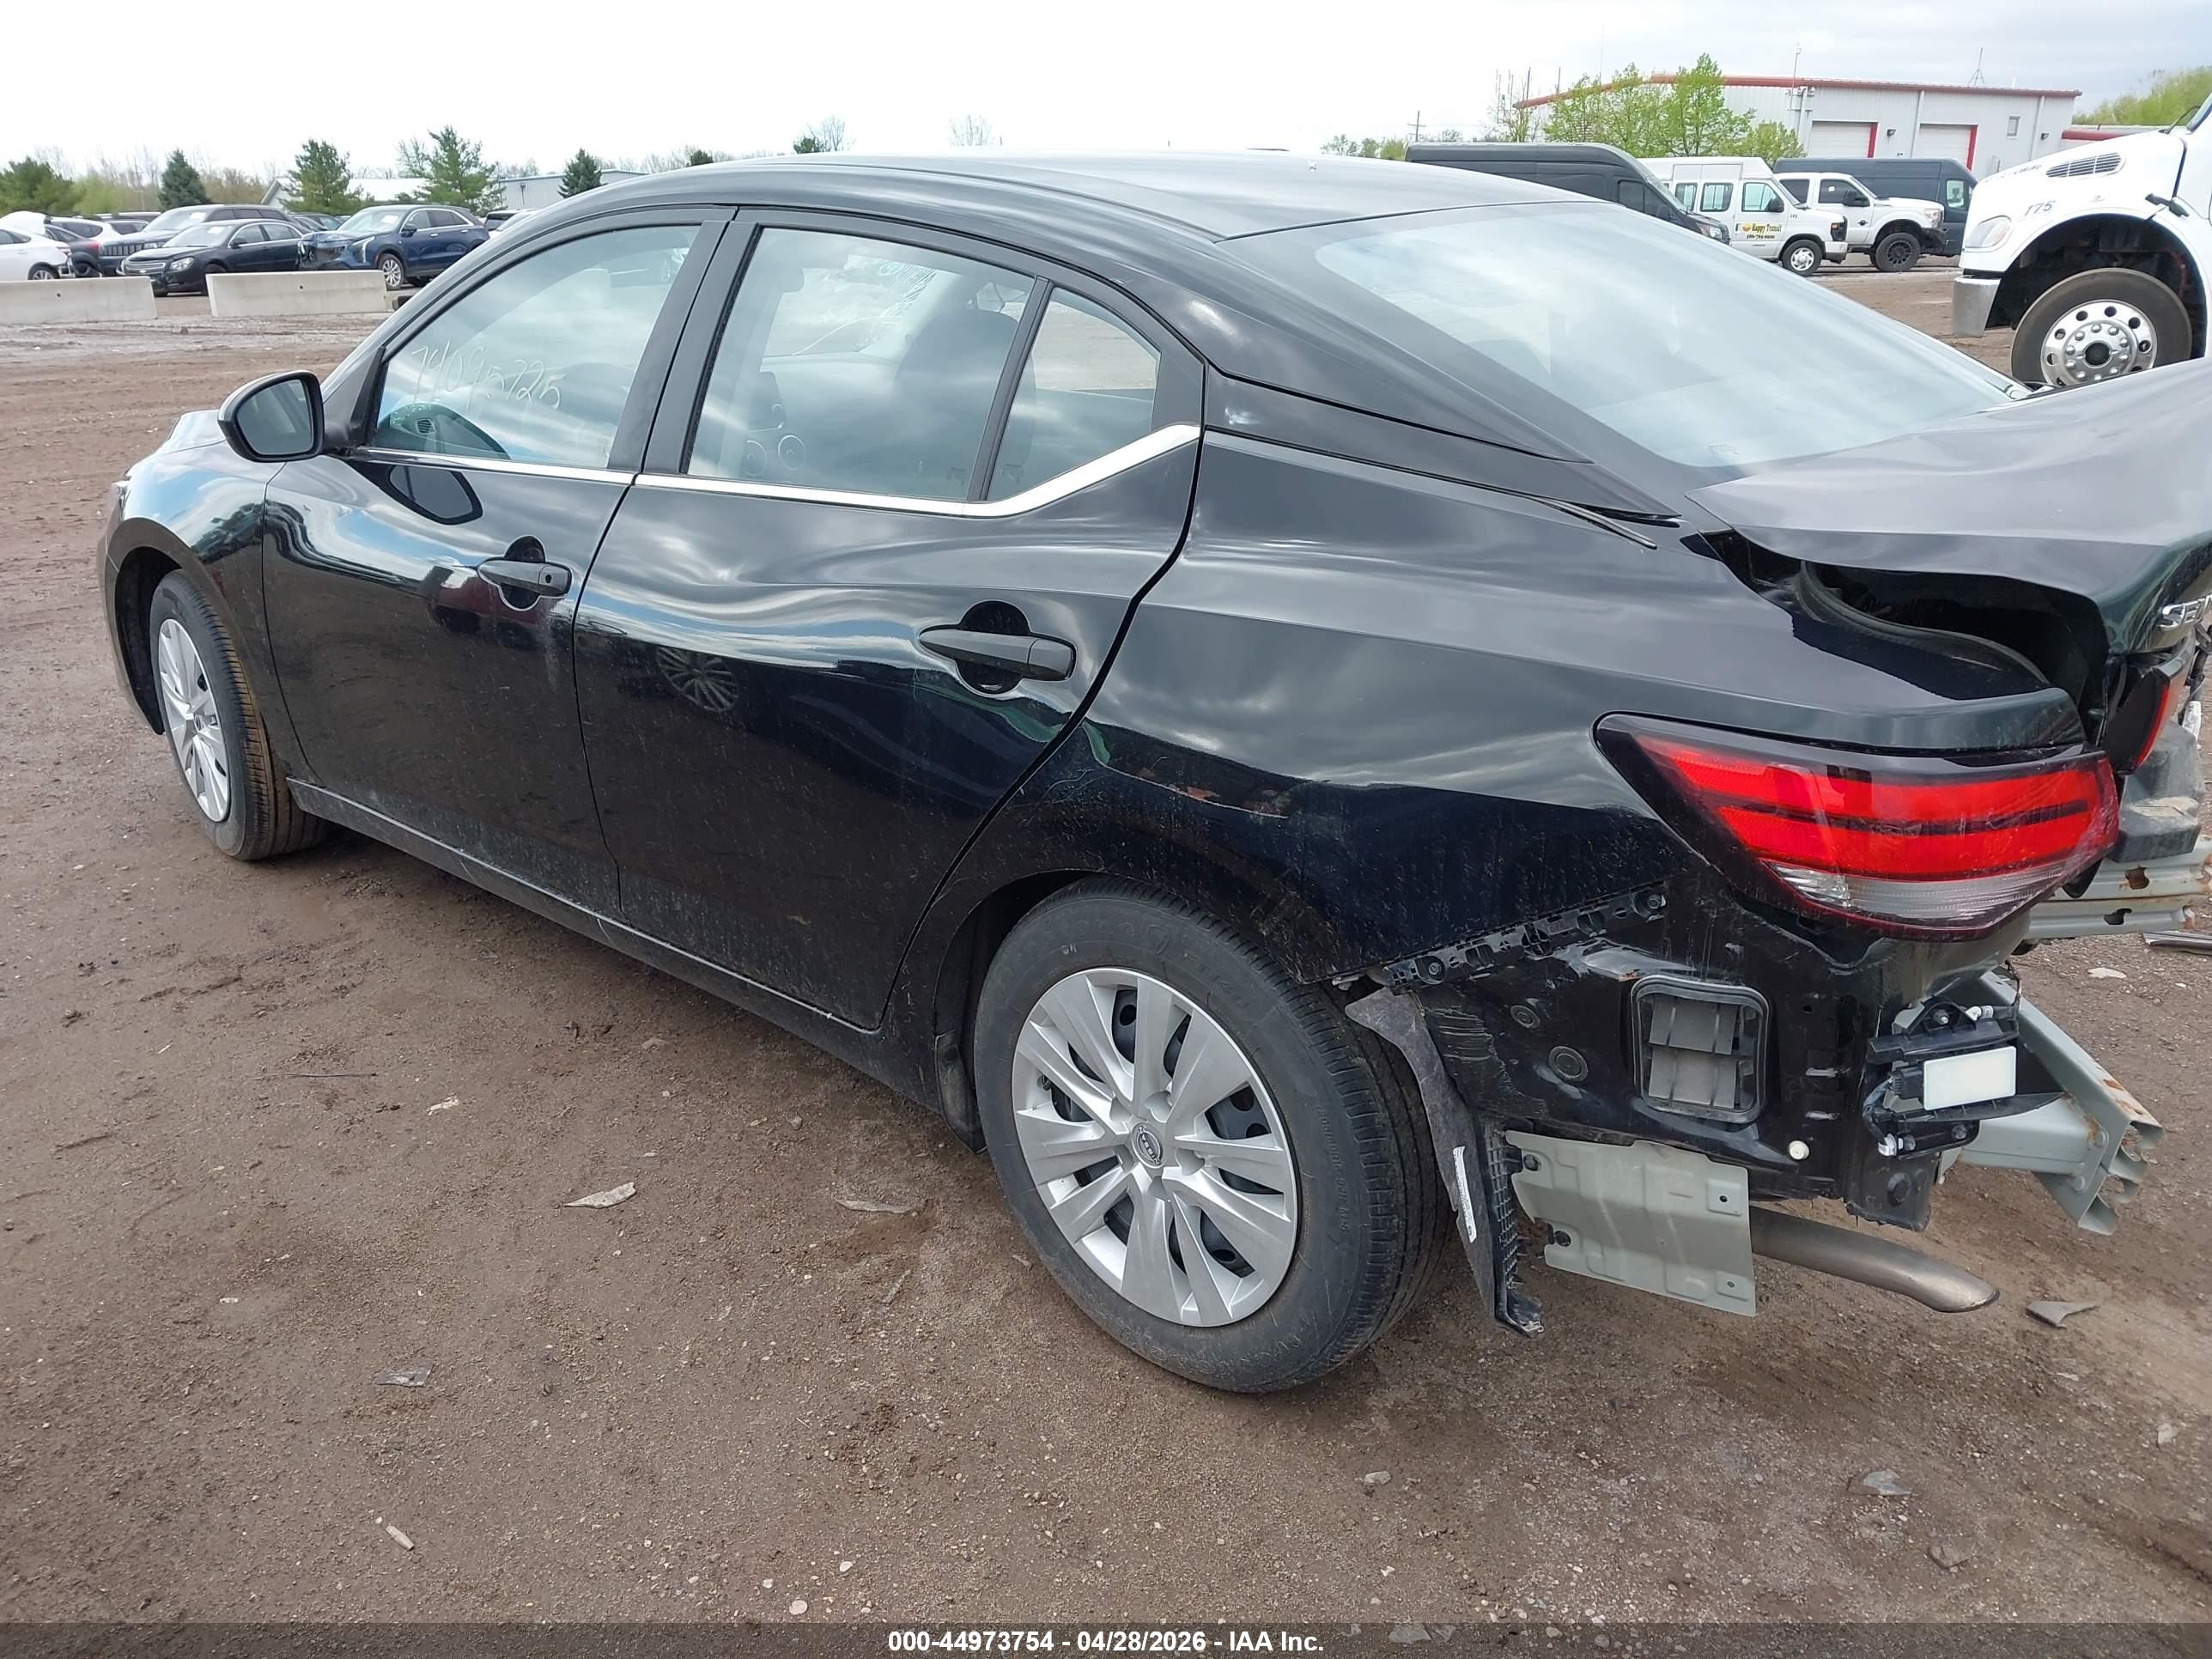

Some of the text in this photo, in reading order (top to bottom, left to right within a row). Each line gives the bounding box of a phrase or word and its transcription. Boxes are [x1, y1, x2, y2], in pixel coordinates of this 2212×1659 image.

[2025, 199, 2057, 216] 175
[1752, 222, 1765, 234] Happy
[1138, 1125, 1161, 1165] NISSAN
